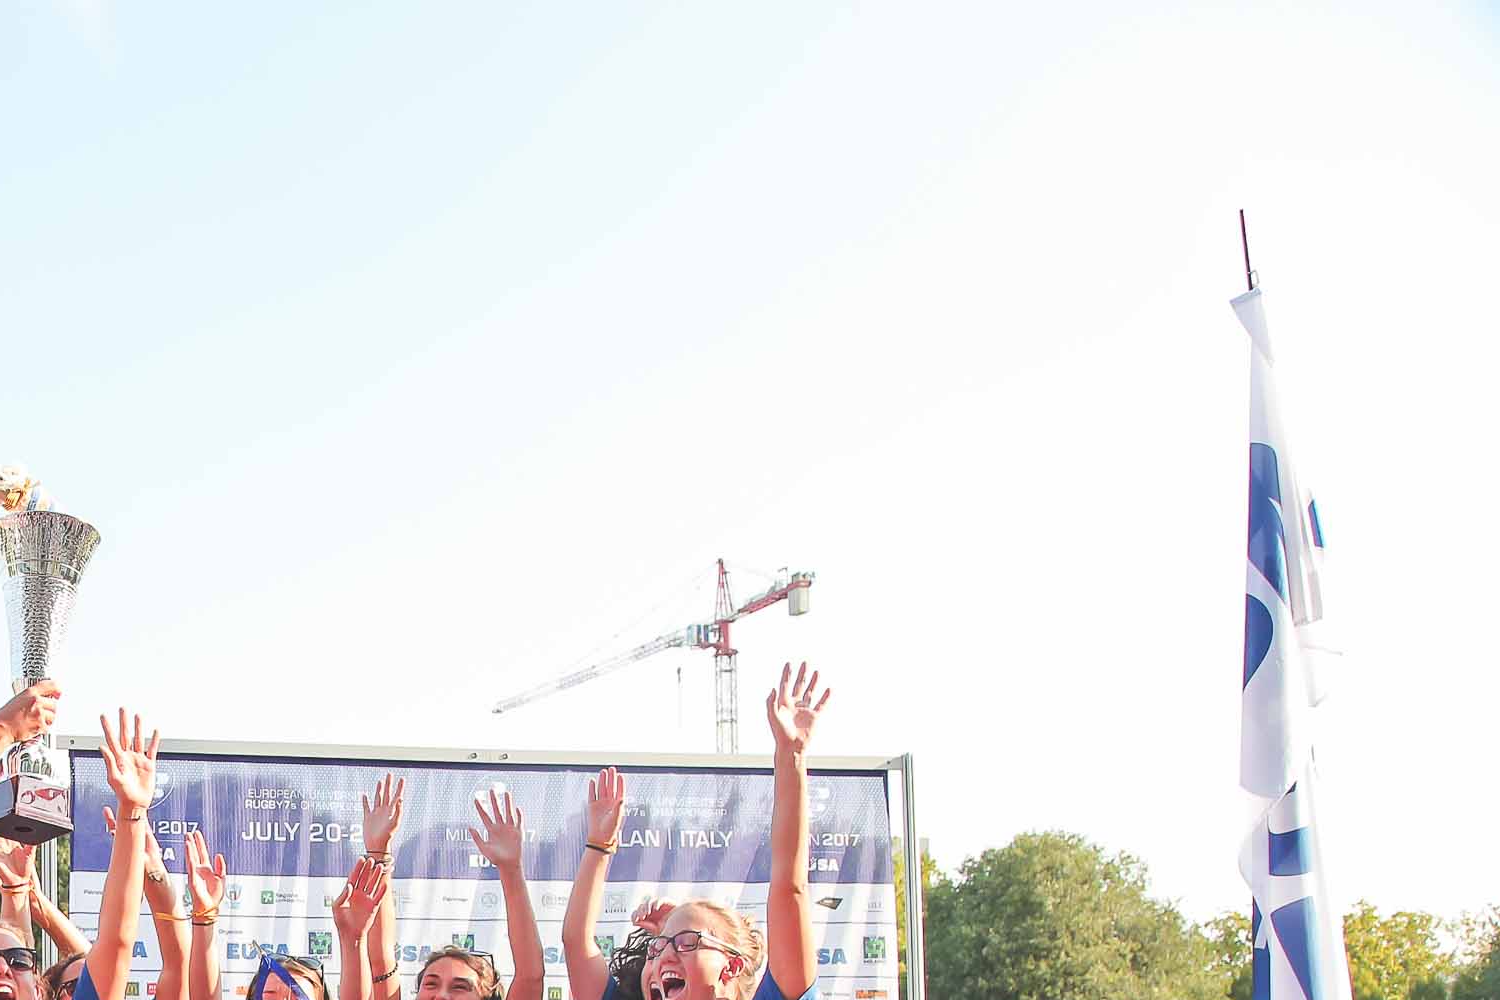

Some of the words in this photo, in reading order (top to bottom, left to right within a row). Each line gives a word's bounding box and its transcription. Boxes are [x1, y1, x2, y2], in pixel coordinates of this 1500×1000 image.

[244, 800, 297, 810] RUGBY7s
[241, 821, 300, 842] JULY
[308, 823, 364, 842] 20-2
[617, 829, 660, 848] LAN
[680, 830, 733, 848] ITALY
